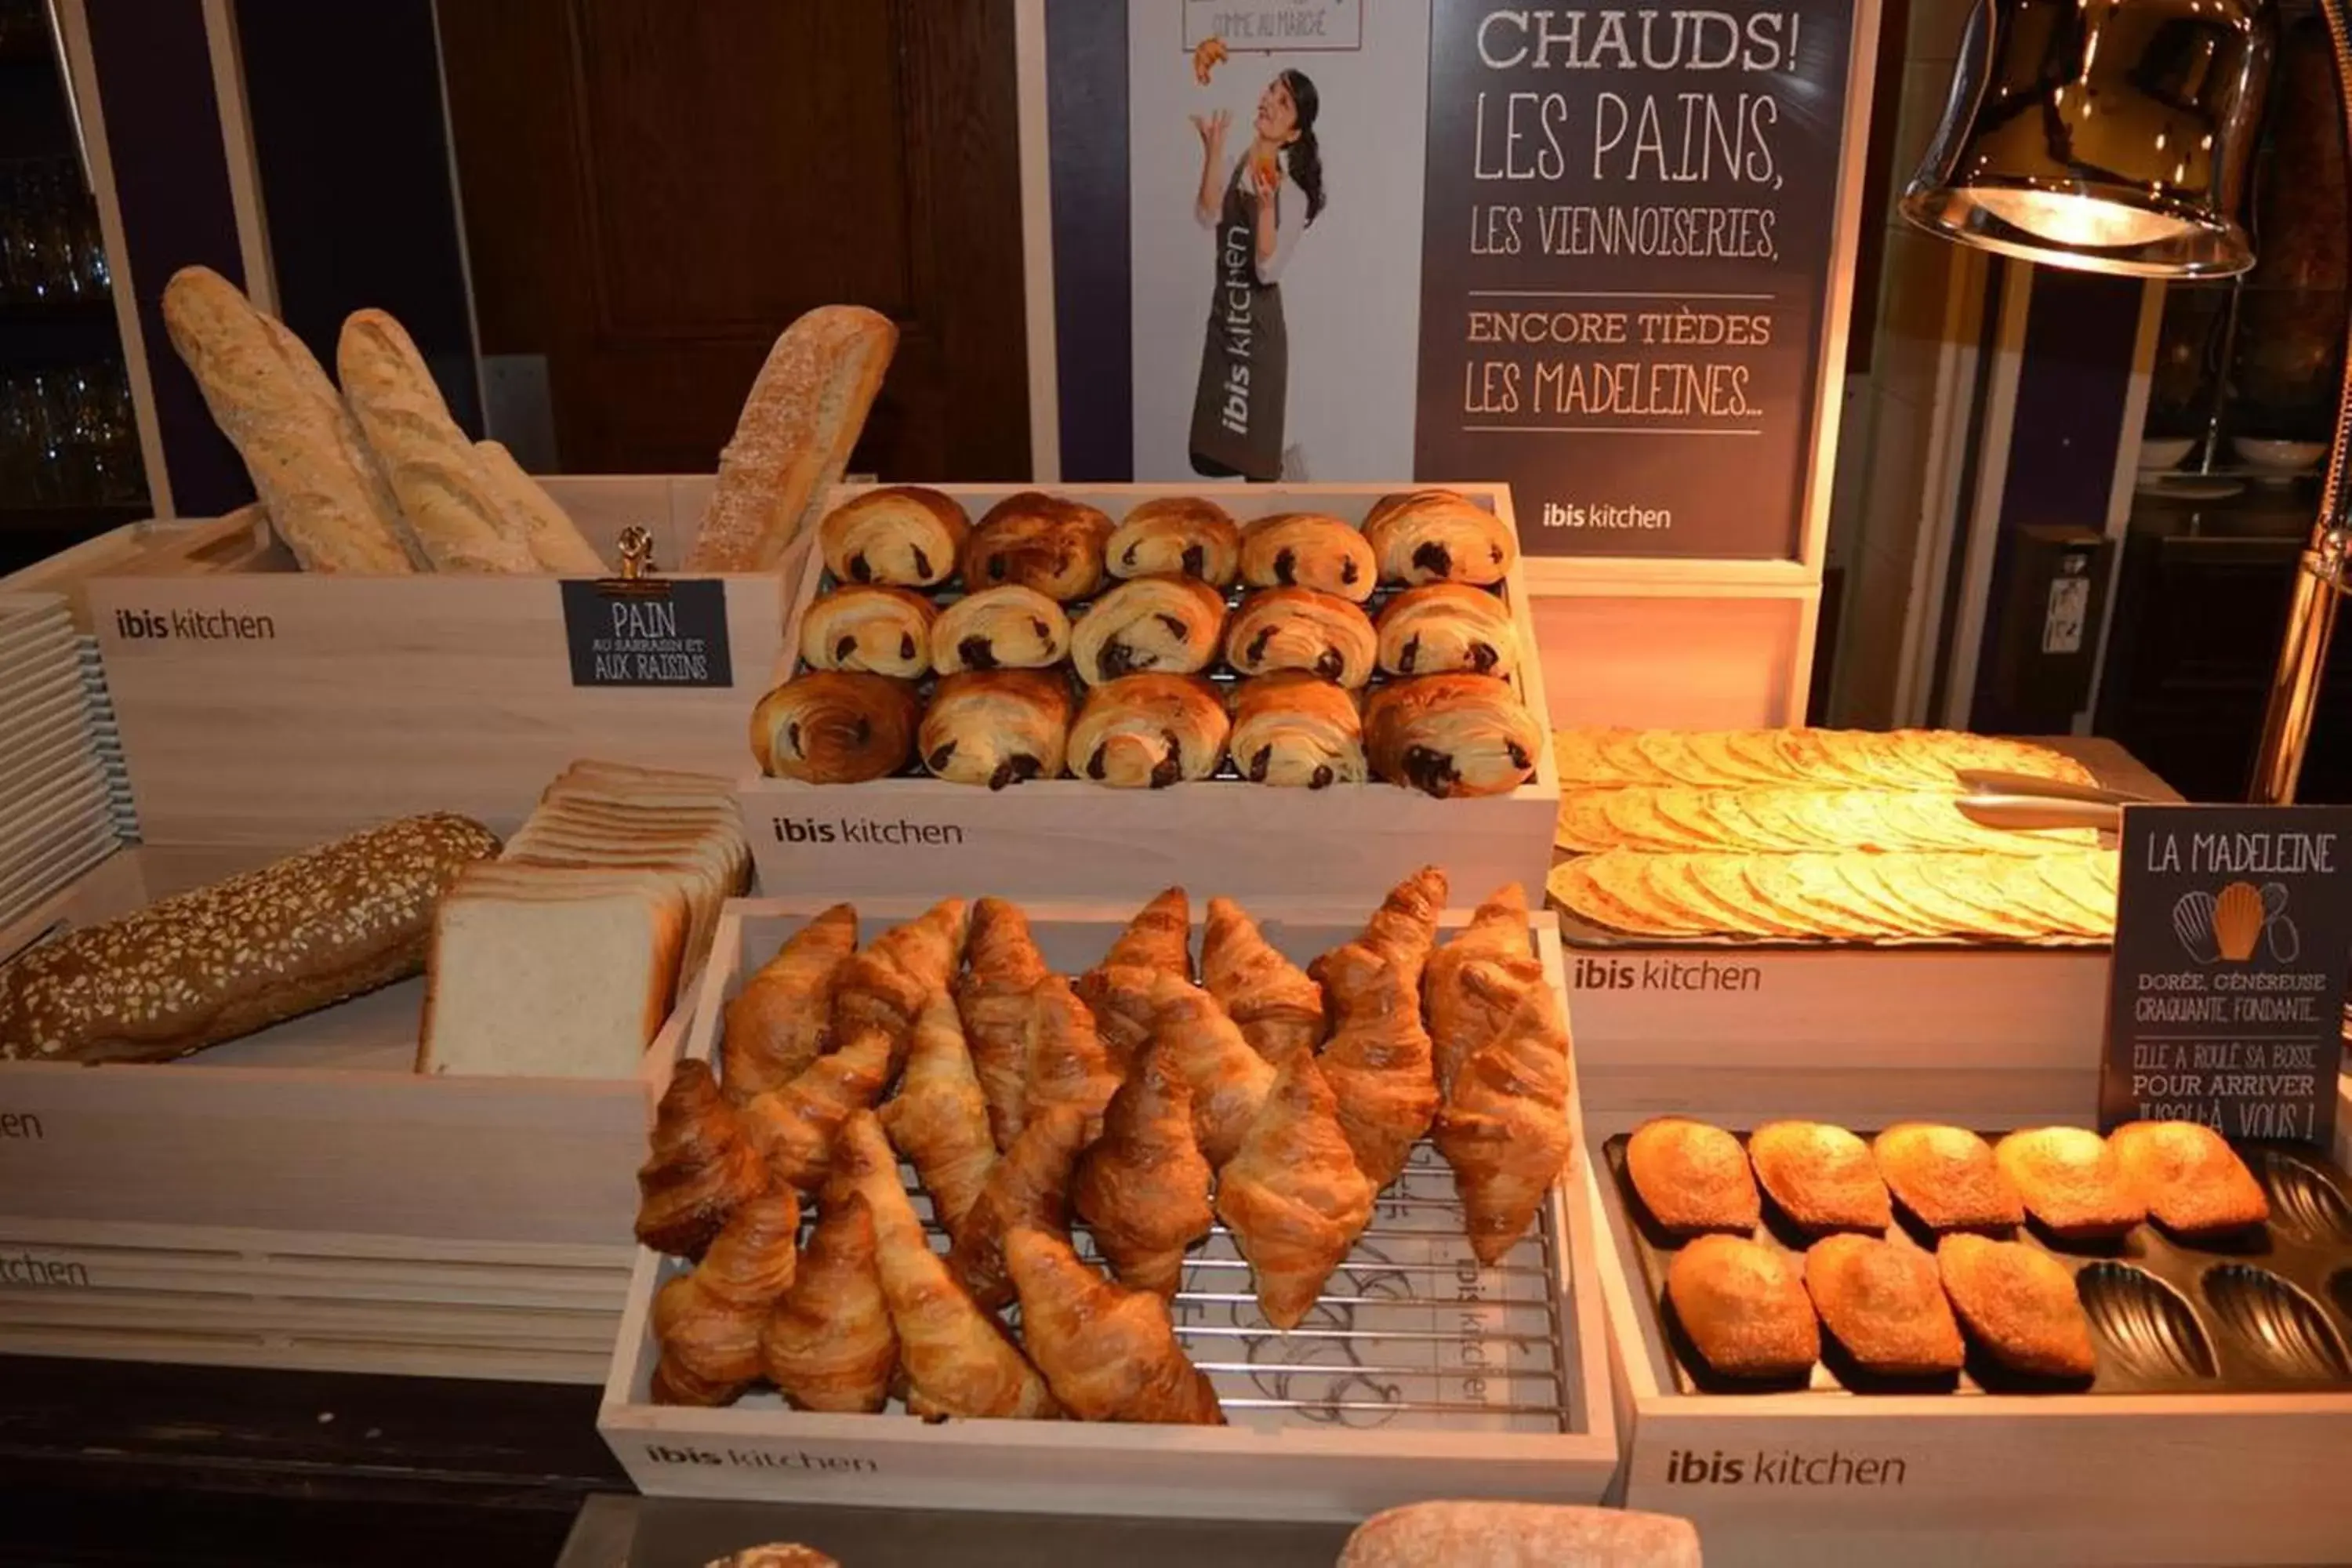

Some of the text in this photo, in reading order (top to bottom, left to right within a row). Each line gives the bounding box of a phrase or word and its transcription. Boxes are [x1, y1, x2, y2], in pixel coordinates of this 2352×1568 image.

[1476, 9, 1800, 72] CHAUDS!
[1474, 91, 1784, 191] LES PAINS,
[1470, 205, 1780, 262] LES VIENNOISERIES,
[1222, 224, 1252, 434] ibis kitchen
[1467, 304, 1773, 346] ENCORE TIÈDES
[1464, 361, 1763, 417] LES MADELEINES...
[1543, 503, 1671, 529] ibis kitchen
[115, 608, 275, 640] ibis kitchen
[612, 601, 677, 638] PAIN
[595, 654, 709, 681] AUX RAISINS
[771, 816, 964, 844] ibis kitchen
[2147, 831, 2337, 873] LA MADELEINE
[1573, 958, 1762, 991] ibis kitchen
[2132, 1044, 2169, 1070] ELLE
[2175, 1046, 2187, 1069] A
[2245, 1044, 2266, 1069] SA
[2274, 1044, 2319, 1069] BOSSE
[2132, 1074, 2315, 1097] POUR ARRIVER
[645, 1444, 879, 1472] ibis kitchen
[1666, 1450, 1907, 1486] ibis kitchen
